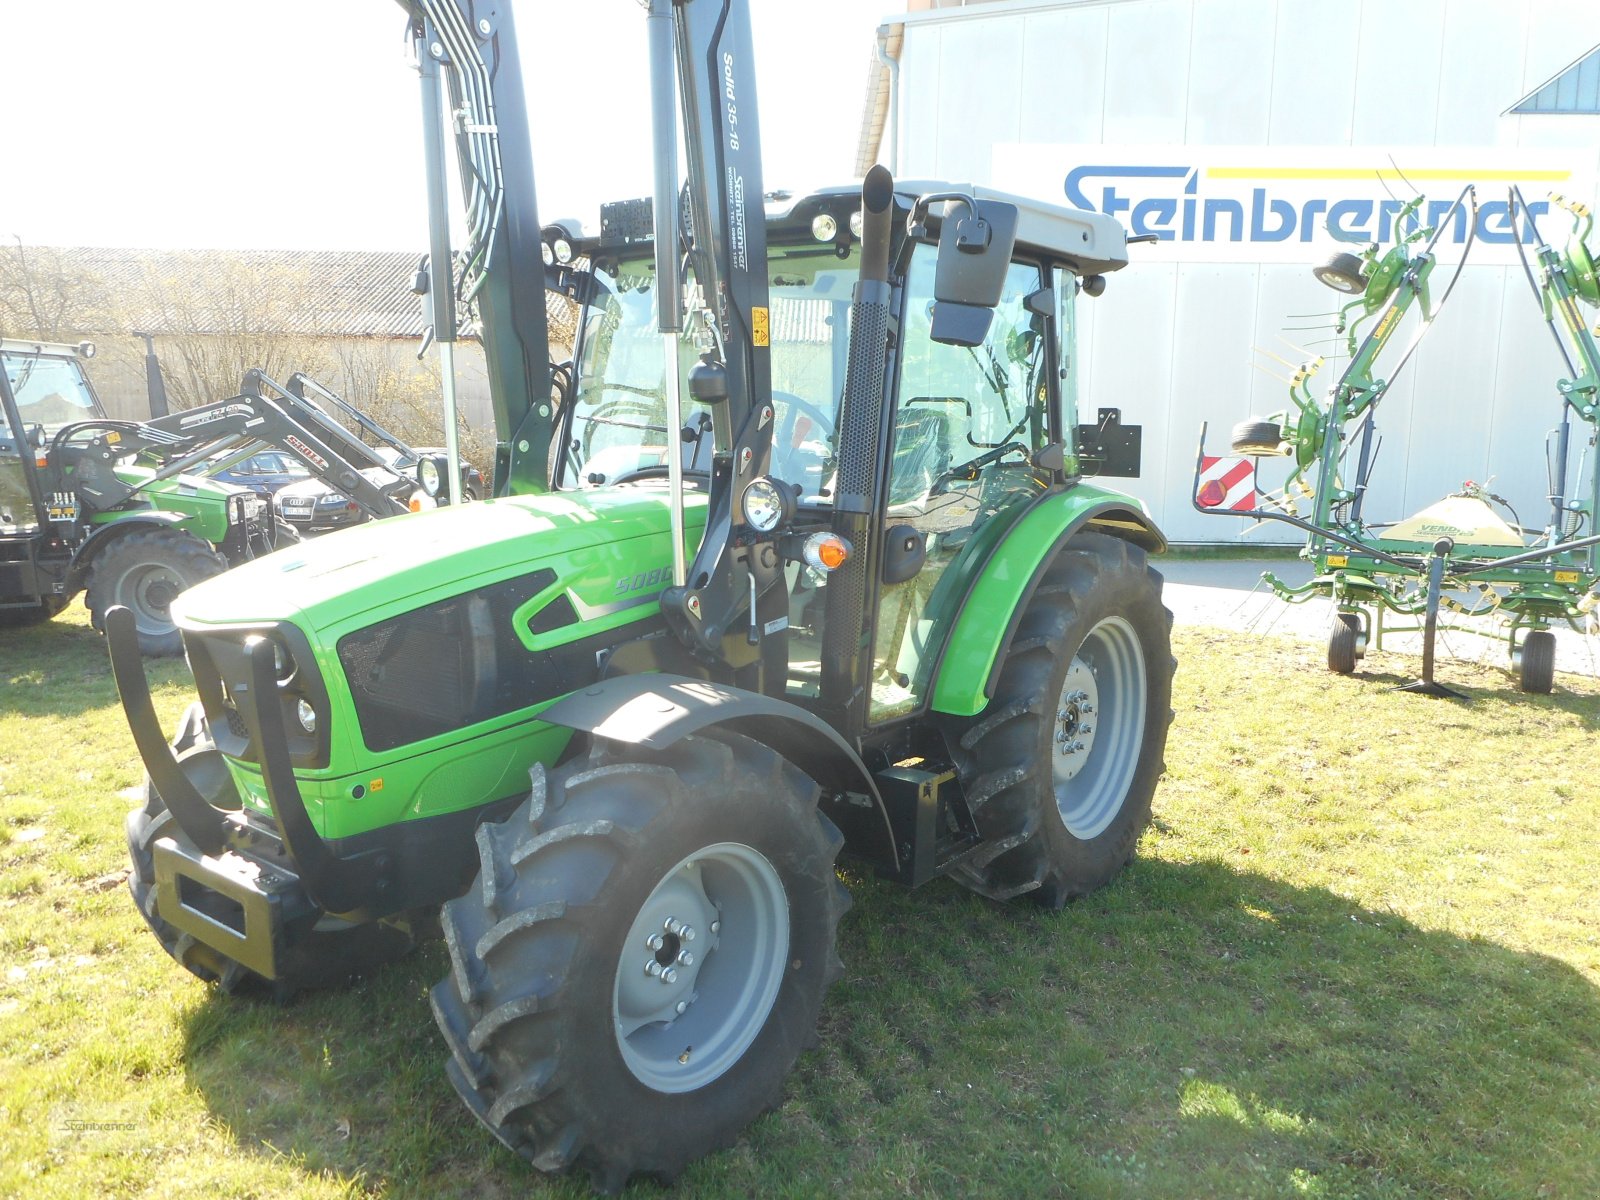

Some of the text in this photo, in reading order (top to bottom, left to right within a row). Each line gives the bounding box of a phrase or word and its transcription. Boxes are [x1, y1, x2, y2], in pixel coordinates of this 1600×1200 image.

[723, 52, 740, 151] Solid 35-18
[733, 166, 748, 272] Steinbrenner
[1065, 166, 1549, 244] Steinbrenner
